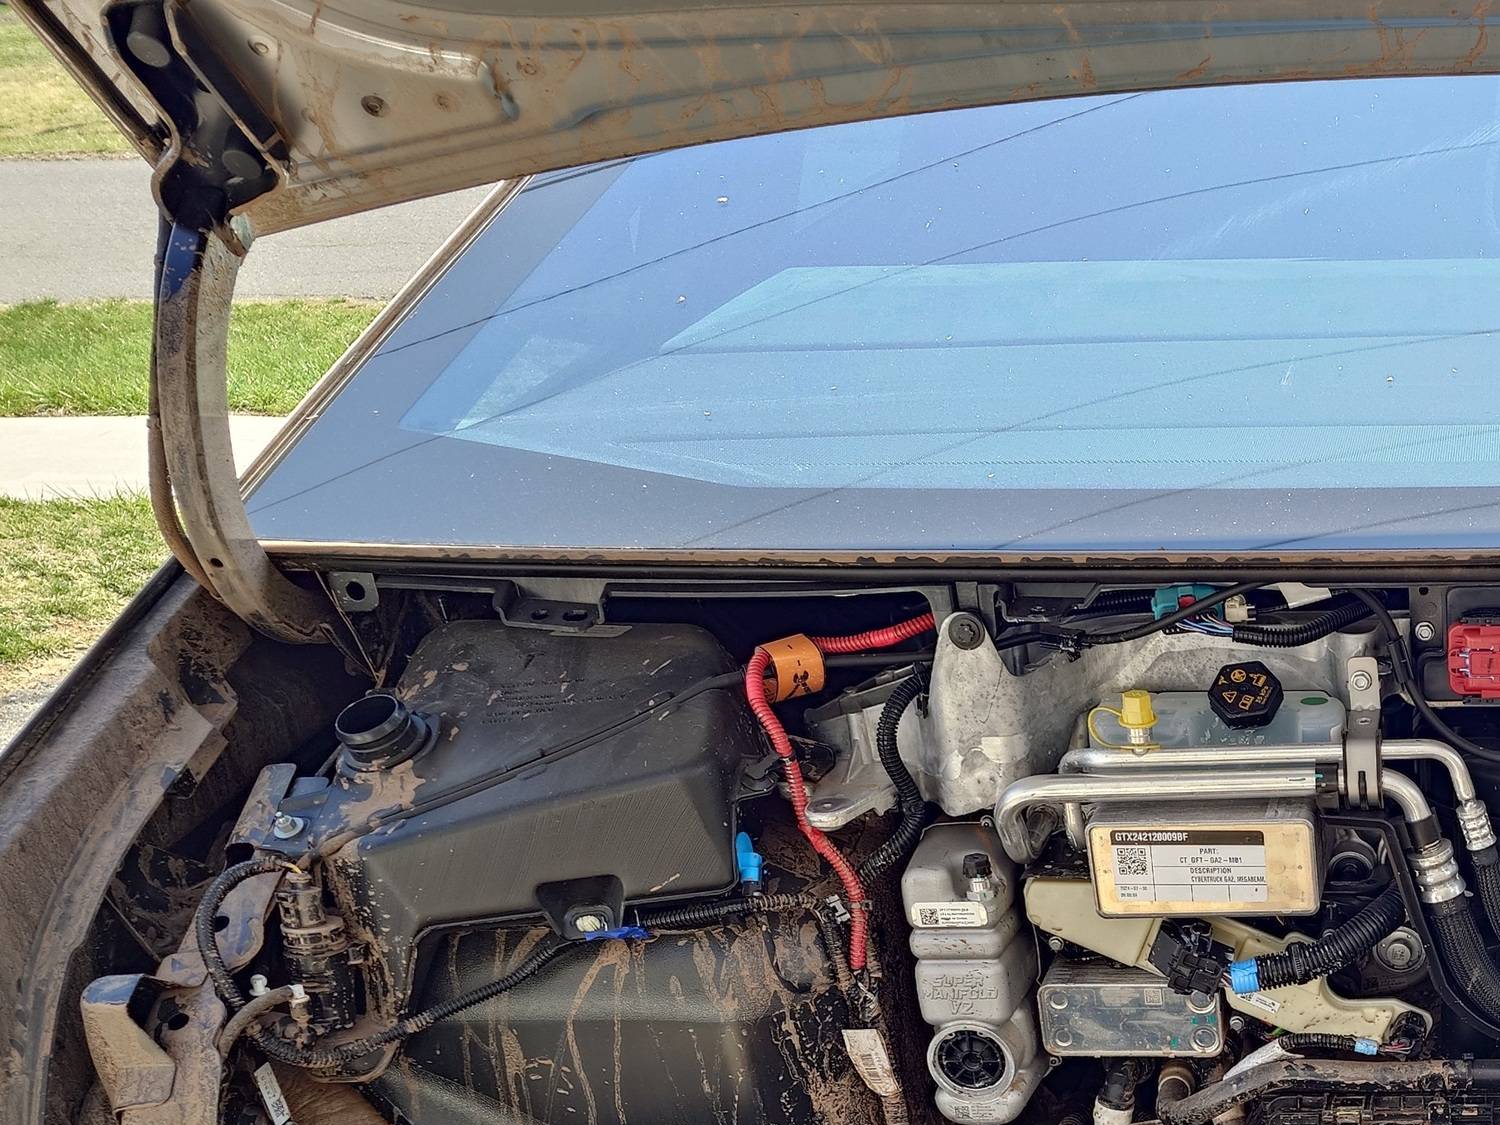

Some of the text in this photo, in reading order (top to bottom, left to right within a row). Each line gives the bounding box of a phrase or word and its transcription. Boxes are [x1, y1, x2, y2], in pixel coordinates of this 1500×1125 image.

[932, 975, 984, 988] SUPER
[921, 987, 999, 1001] MANIFOLD
[950, 1001, 975, 1016] V2
